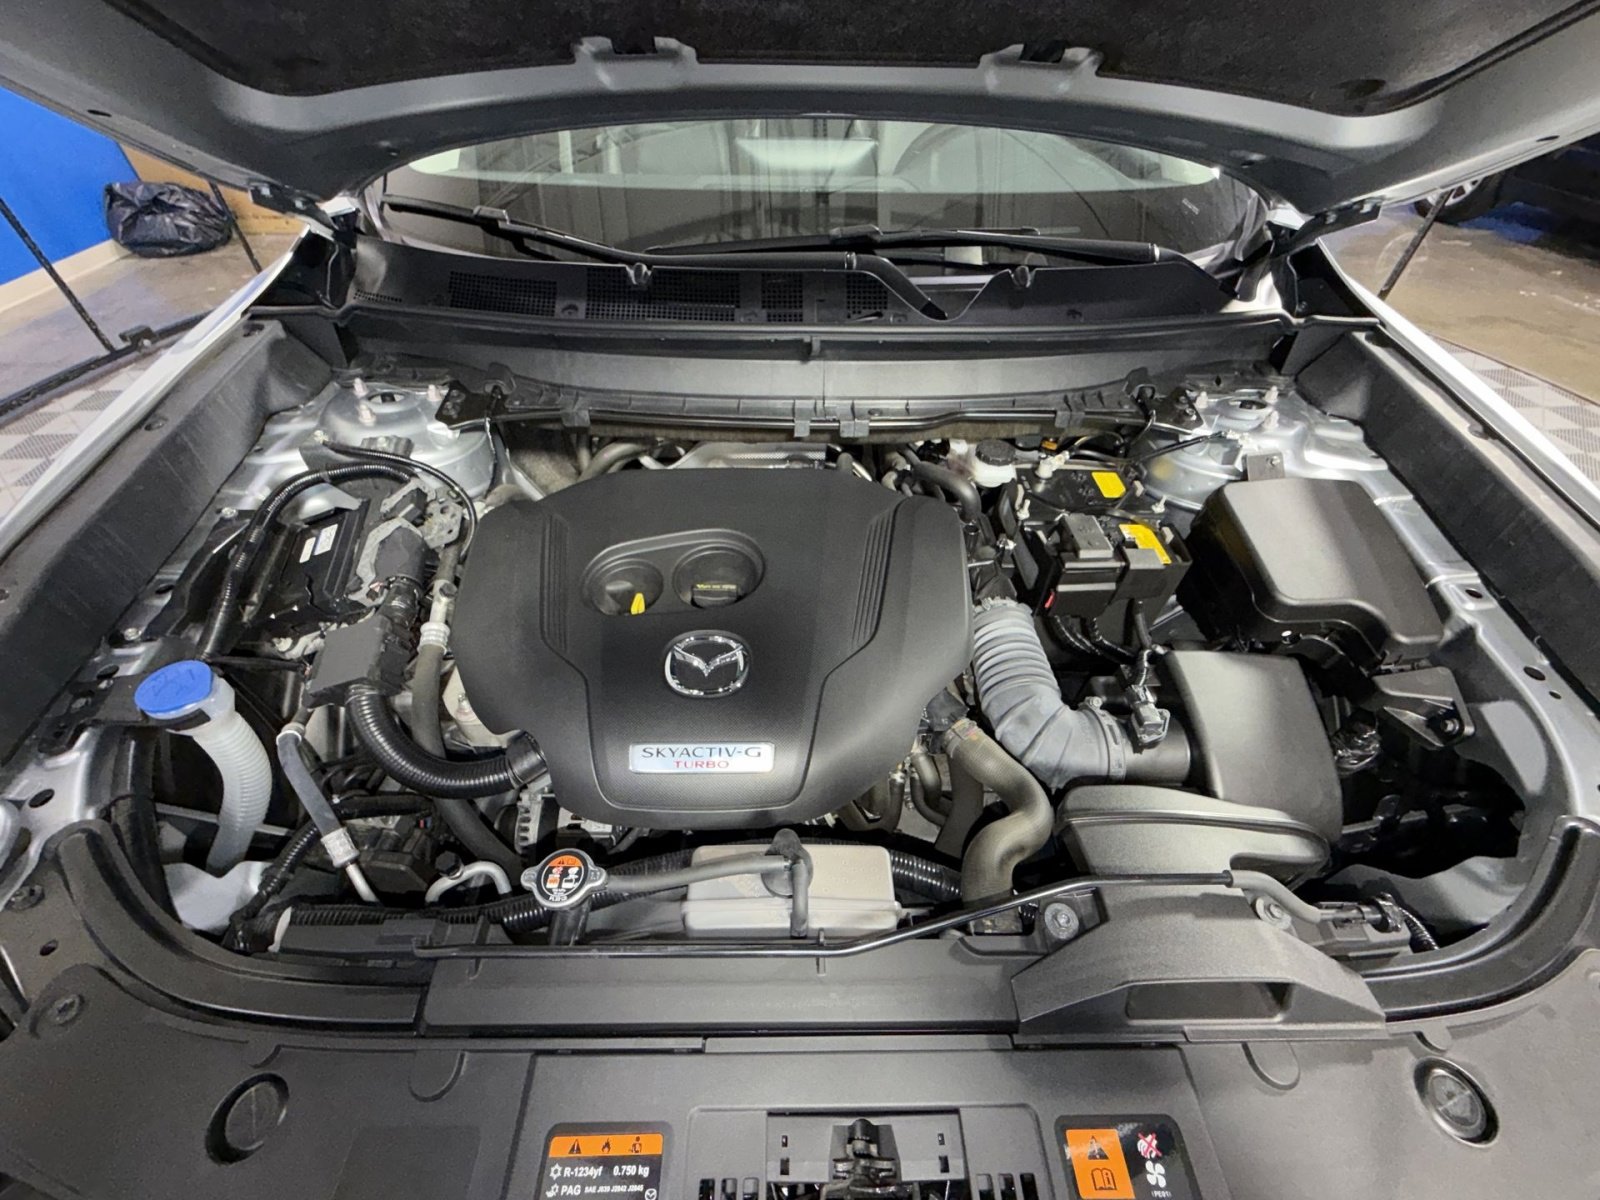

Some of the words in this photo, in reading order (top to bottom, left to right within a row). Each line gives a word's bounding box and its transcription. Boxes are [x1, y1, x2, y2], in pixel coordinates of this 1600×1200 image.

[641, 746, 762, 759] SKYACTIV-G
[674, 760, 731, 769] TURBO
[563, 1166, 603, 1179] R-1234yf
[613, 1165, 636, 1176] 0.750
[638, 1165, 650, 1178] kg
[560, 1184, 581, 1196] PAG
